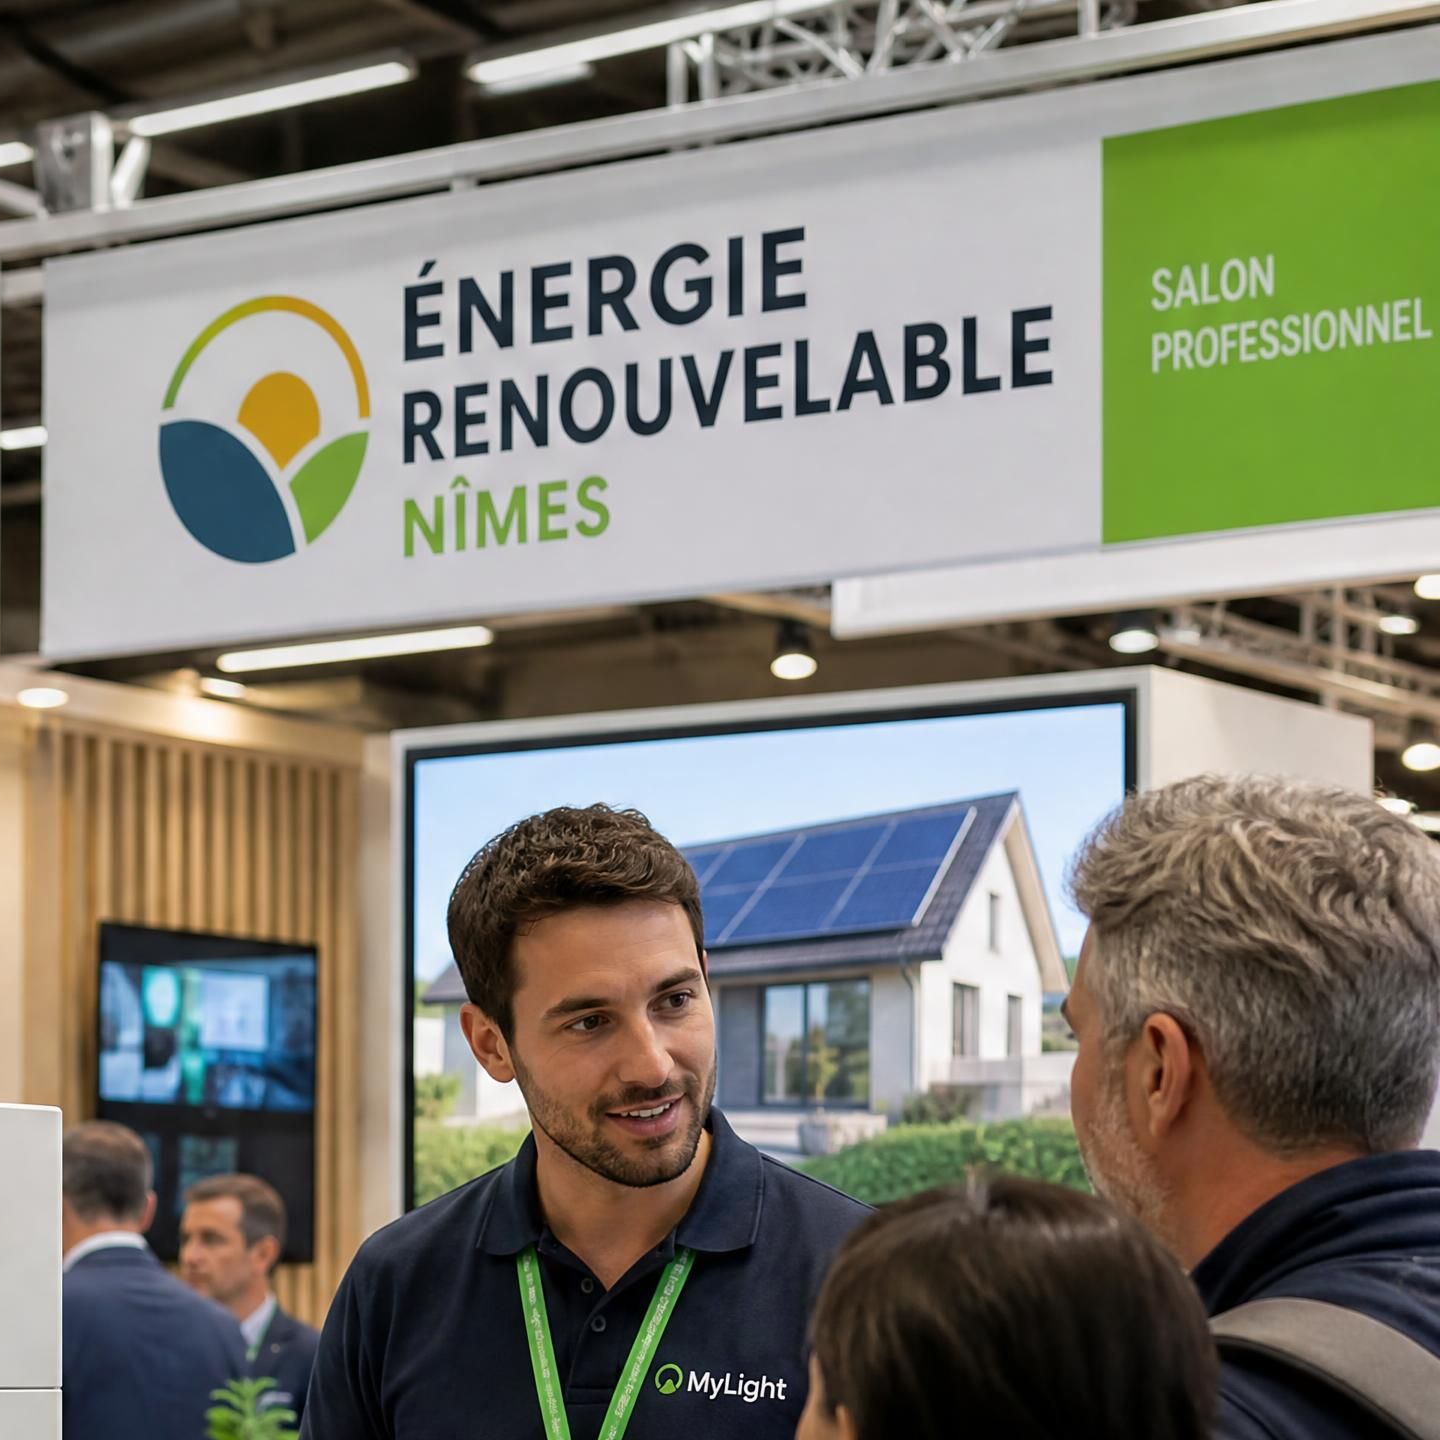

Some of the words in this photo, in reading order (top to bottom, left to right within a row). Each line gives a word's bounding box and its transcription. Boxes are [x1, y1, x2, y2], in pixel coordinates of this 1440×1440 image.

[404, 226, 808, 362] ÉNERGIE
[1152, 255, 1274, 311] SALON
[1151, 297, 1433, 374] PROFESSIONNEL
[403, 305, 1053, 464] RENOUVELABLE
[404, 476, 610, 557] NÎMES
[688, 1371, 787, 1402] MyLight
